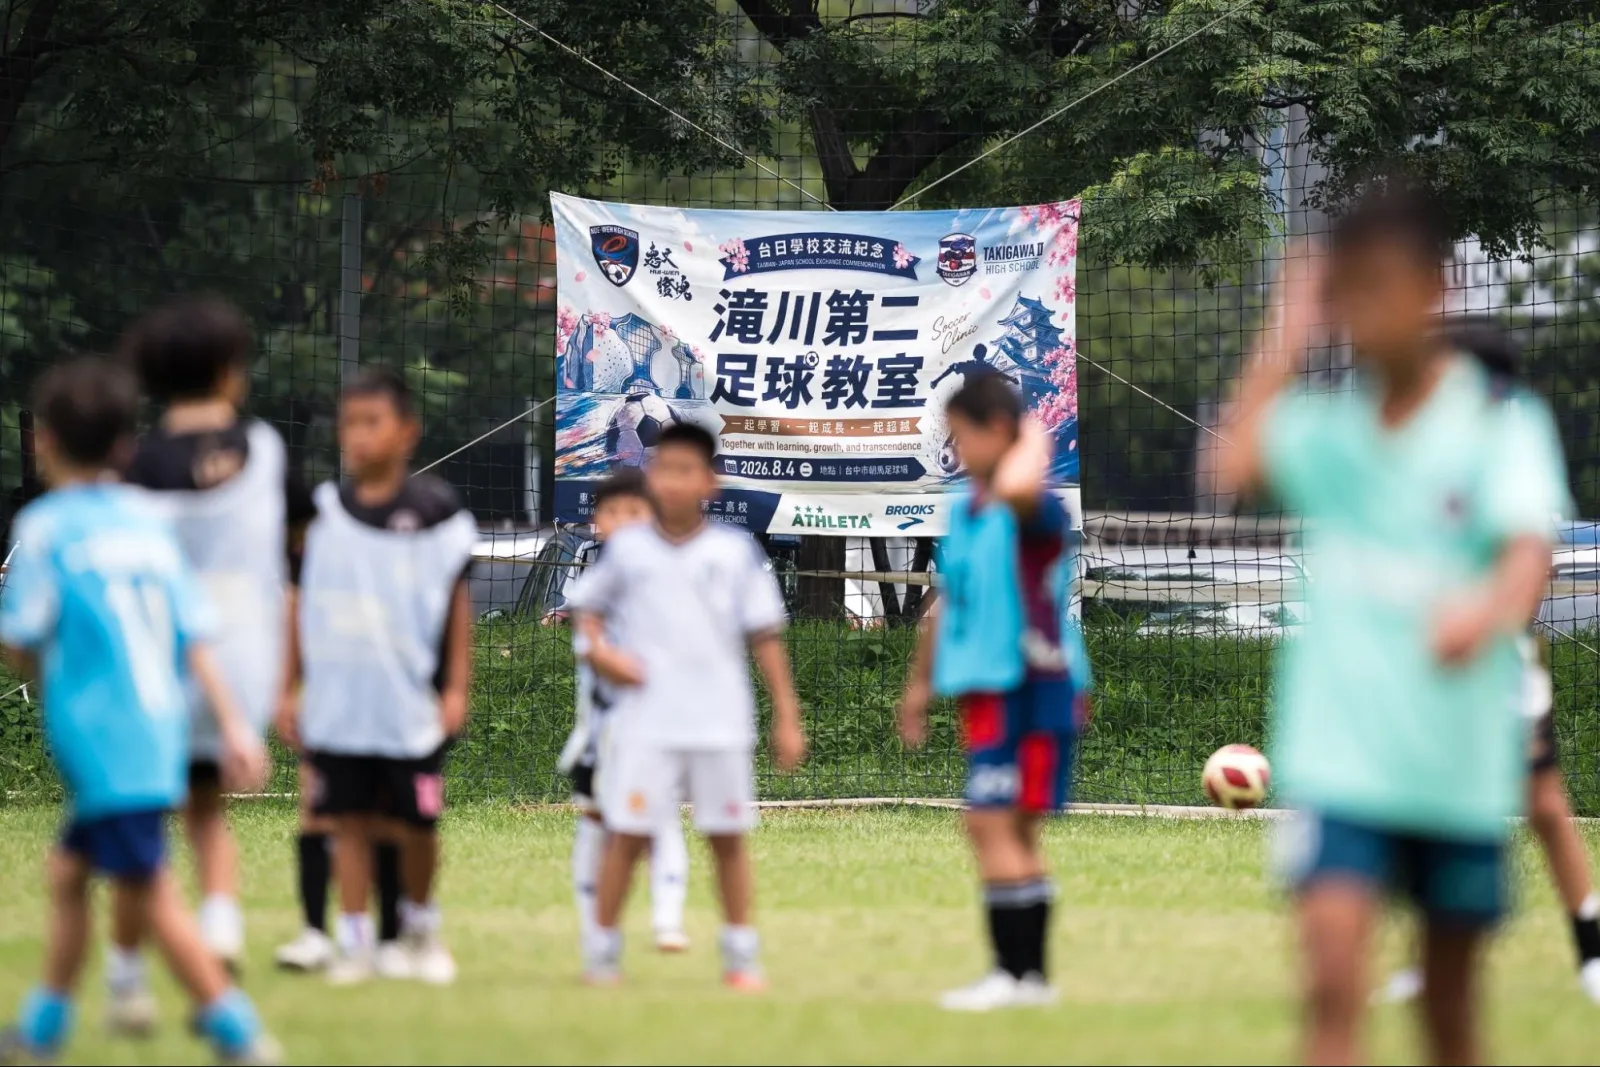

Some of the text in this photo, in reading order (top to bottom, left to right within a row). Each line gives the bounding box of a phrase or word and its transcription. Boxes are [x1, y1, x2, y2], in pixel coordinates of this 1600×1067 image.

[758, 237, 885, 259] 台日學校交流紀念
[983, 243, 1035, 261] TAKIGAWA
[795, 258, 815, 266] SCHOOL
[815, 257, 842, 266] EXCHANGE
[842, 259, 886, 270] COMMEMORATION
[985, 259, 1040, 275] HIGH SCHOOL
[708, 288, 920, 346] 滝川第二
[931, 311, 971, 341] Soccer
[941, 324, 979, 354] Clinic
[709, 352, 927, 410] 足球教室
[721, 438, 922, 453] Together with learning, growth, and transcendence
[740, 460, 795, 477] 2026.8.4
[700, 499, 748, 513] 第二高校
[885, 504, 936, 516] BROOKS
[709, 514, 724, 523] HIGH
[724, 514, 748, 524] SCHOOL
